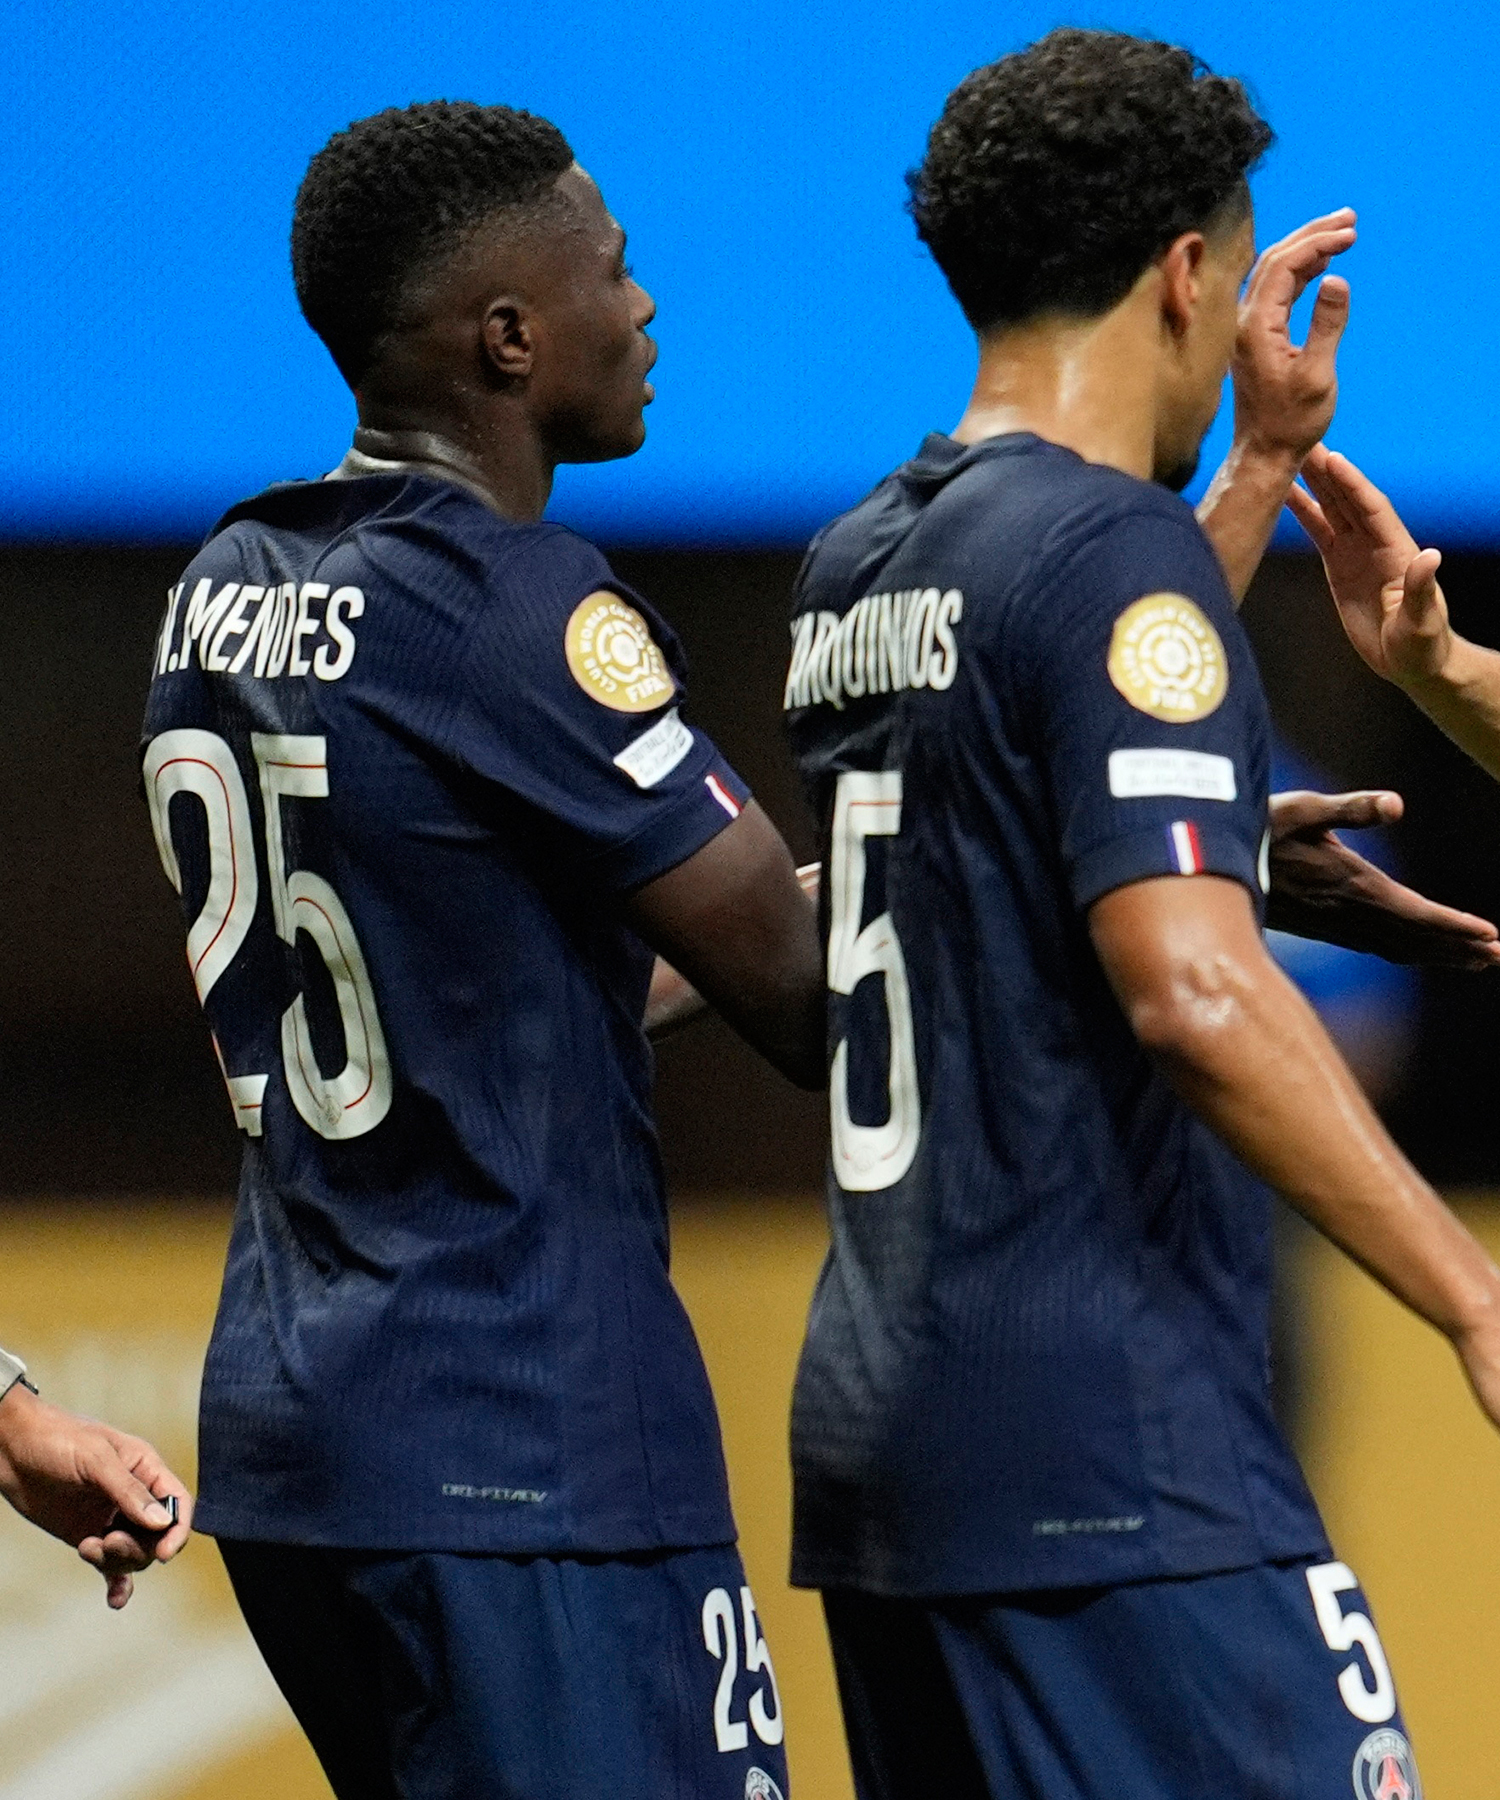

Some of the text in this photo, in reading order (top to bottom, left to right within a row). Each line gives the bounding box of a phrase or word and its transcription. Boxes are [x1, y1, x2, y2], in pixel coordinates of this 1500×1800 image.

[142, 728, 393, 1140] 25
[828, 771, 921, 1192] 5
[702, 1586, 784, 1753] 25
[1306, 1561, 1396, 1723] 5
